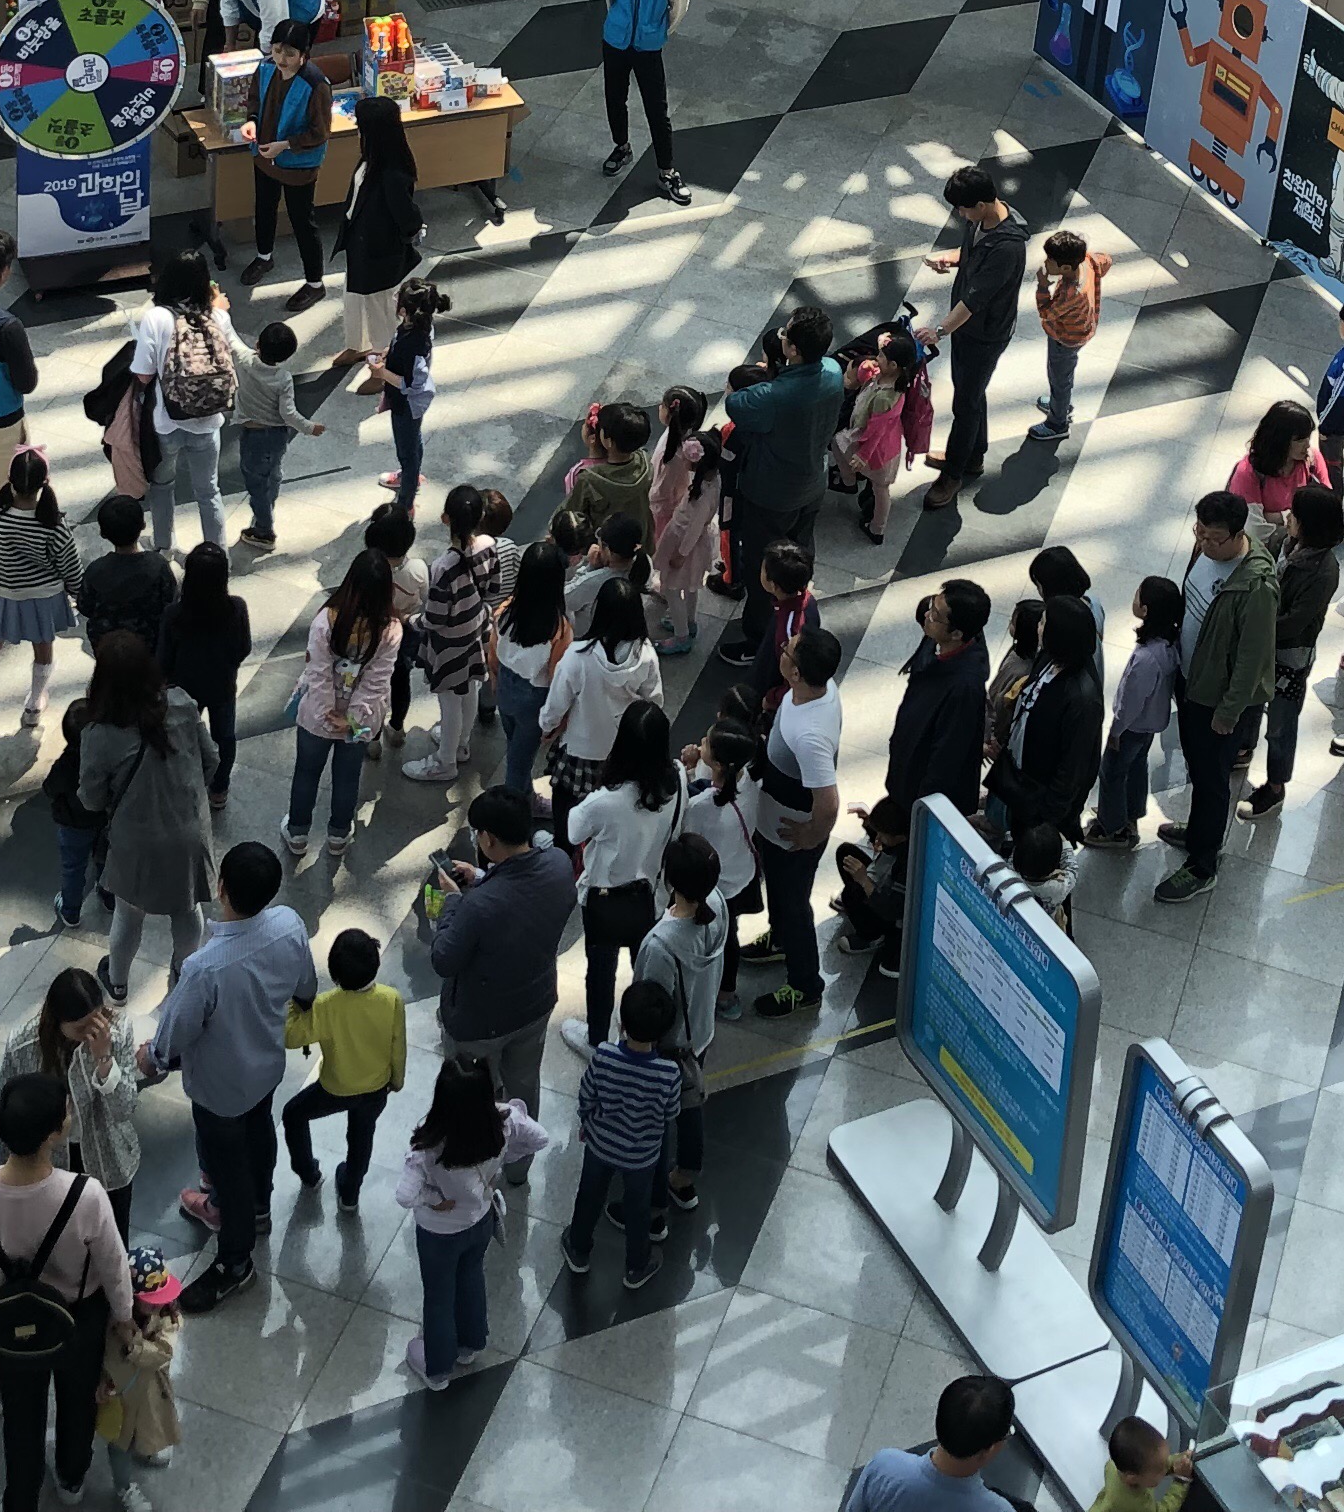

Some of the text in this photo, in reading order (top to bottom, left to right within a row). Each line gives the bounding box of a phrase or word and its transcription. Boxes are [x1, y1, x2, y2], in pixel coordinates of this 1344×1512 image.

[44, 169, 140, 197] 2019 과학의
[120, 189, 144, 216] 날
